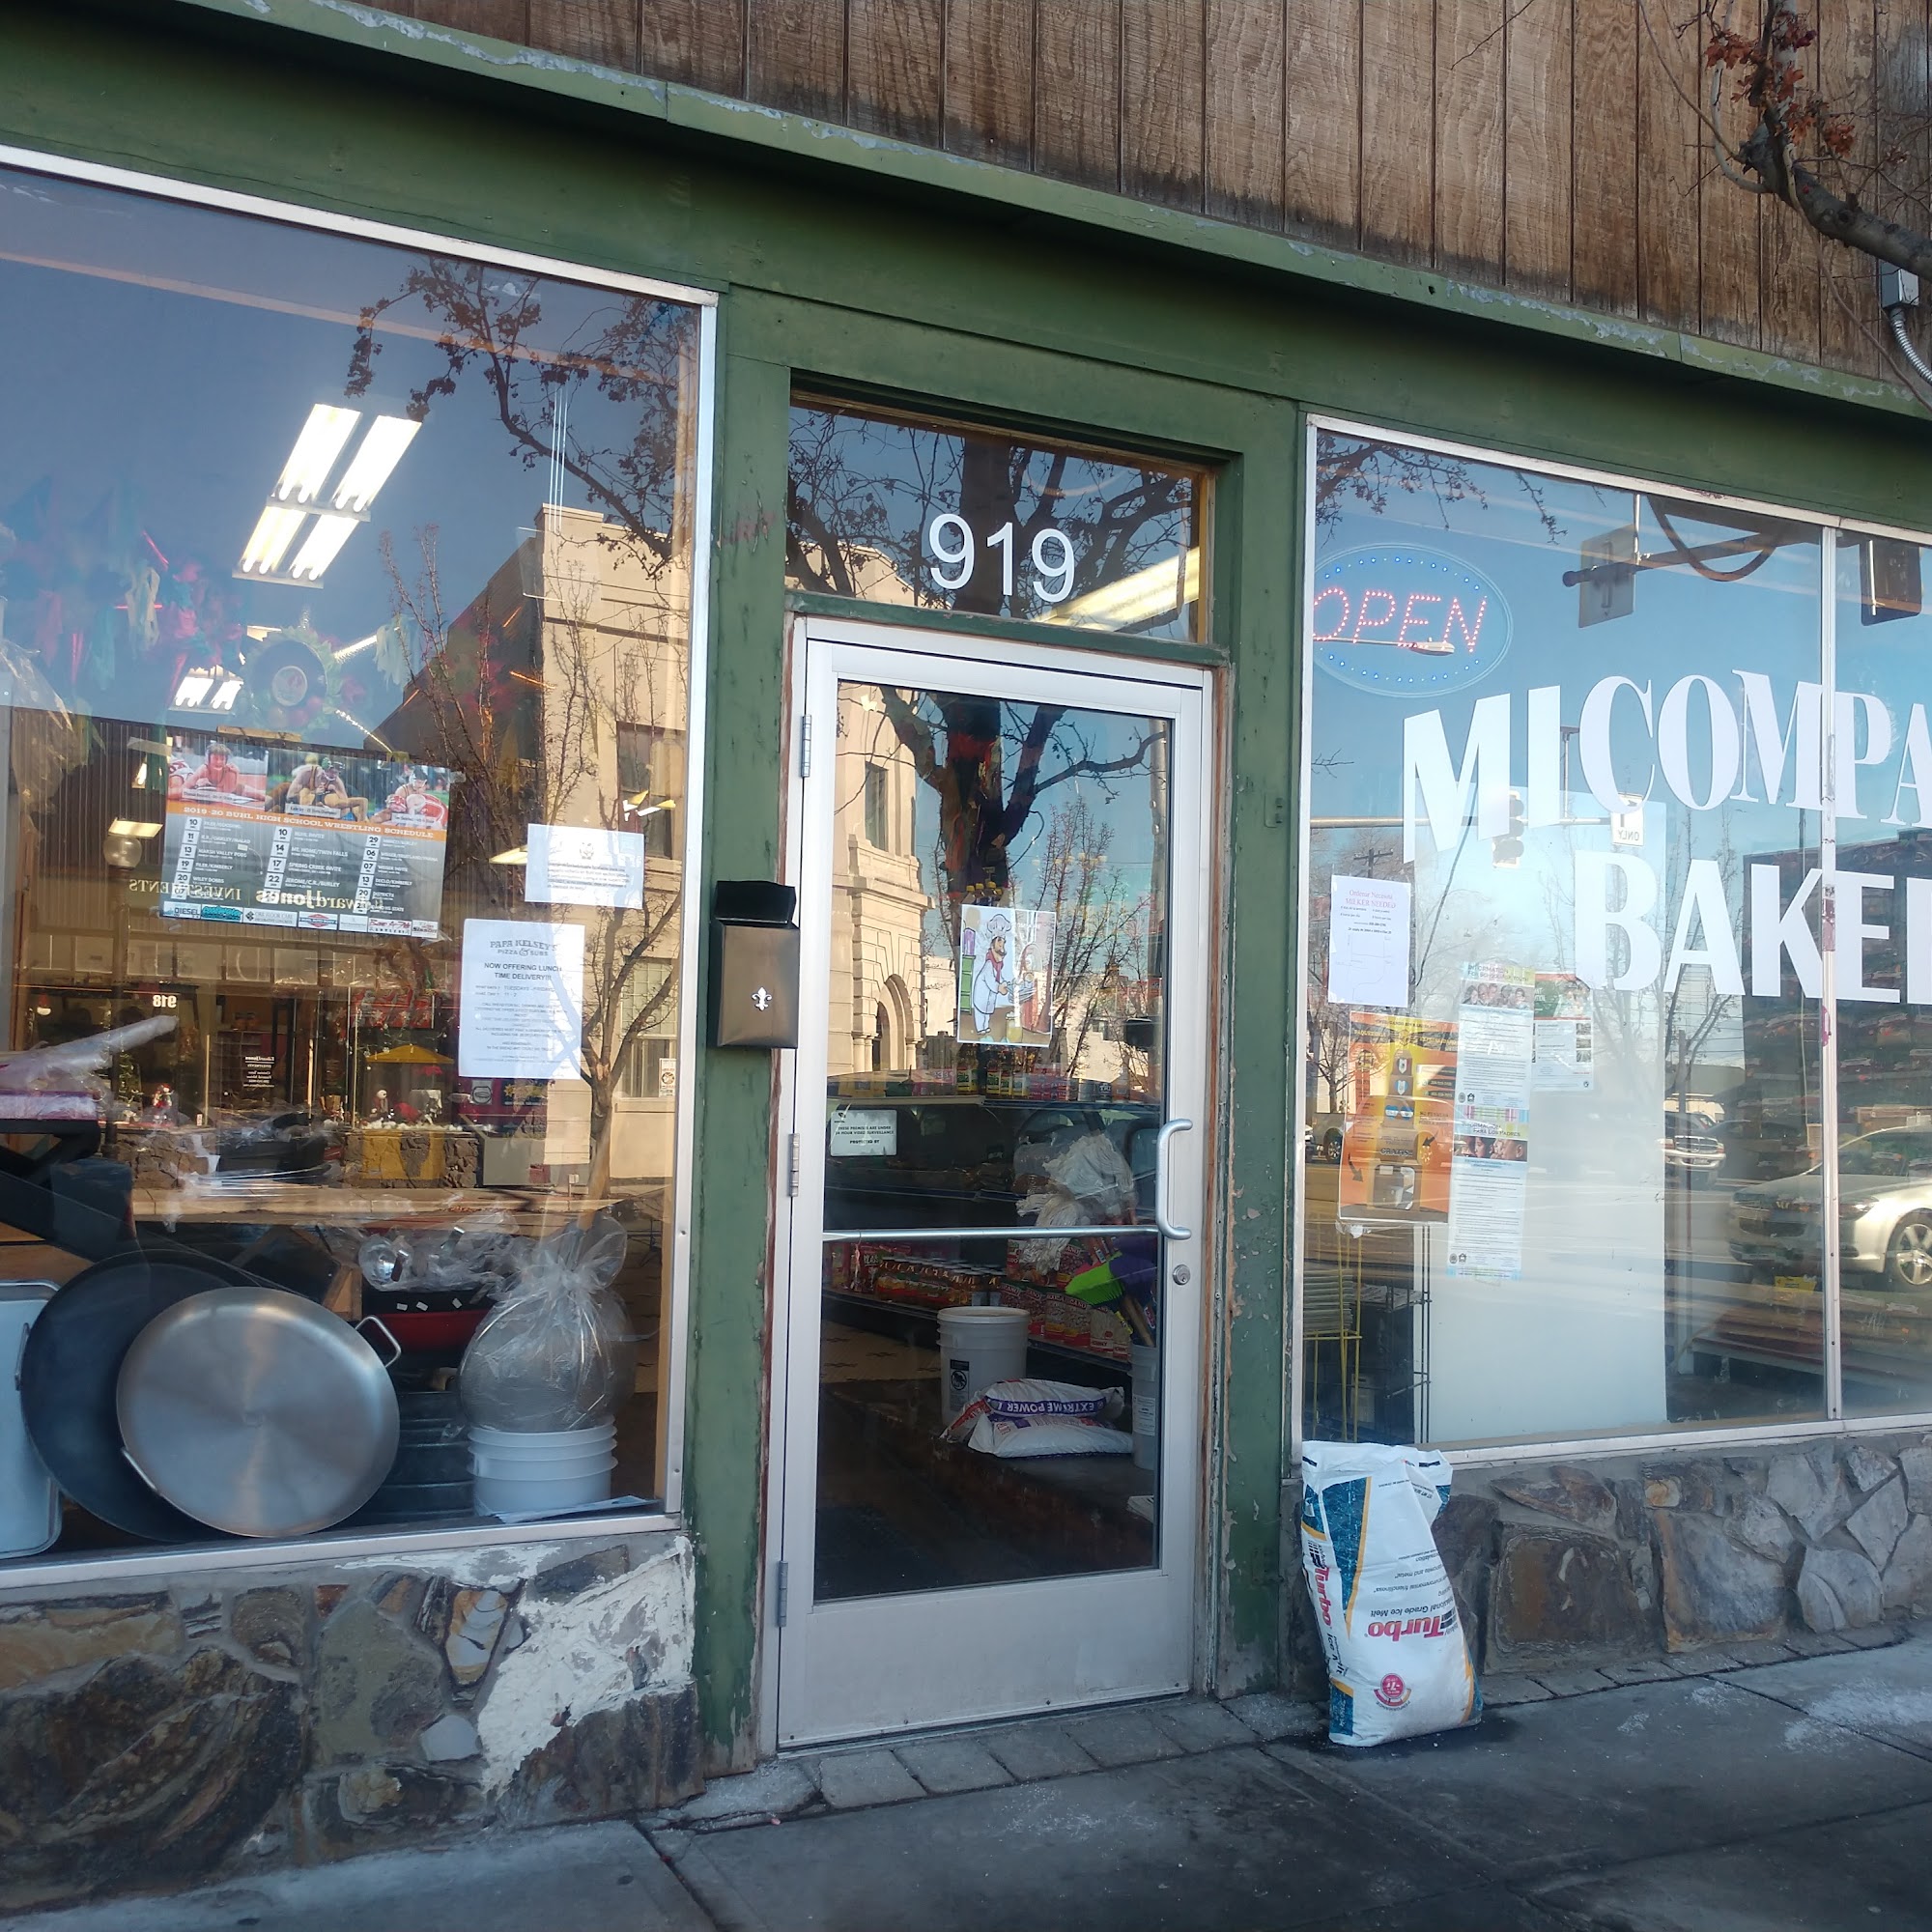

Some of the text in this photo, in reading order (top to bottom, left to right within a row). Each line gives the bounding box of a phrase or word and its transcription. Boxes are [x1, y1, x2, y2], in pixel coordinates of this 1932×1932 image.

[928, 513, 1075, 603] 919
[1313, 585, 1488, 654] OPEN
[1403, 684, 1562, 864] MI
[226, 811, 254, 820] BUHL
[255, 814, 281, 823] HIGH
[283, 816, 324, 827] SCHOOL
[325, 821, 382, 833] WRESTLING
[384, 827, 434, 838] SCHEDULE
[174, 907, 200, 916] DIESEL
[1346, 898, 1370, 907] MILKER
[490, 939, 513, 949] PAPA
[1008, 1402, 1046, 1412] POWER
[1314, 1567, 1332, 1627] Turbo
[1367, 1615, 1444, 1642] Turbo
